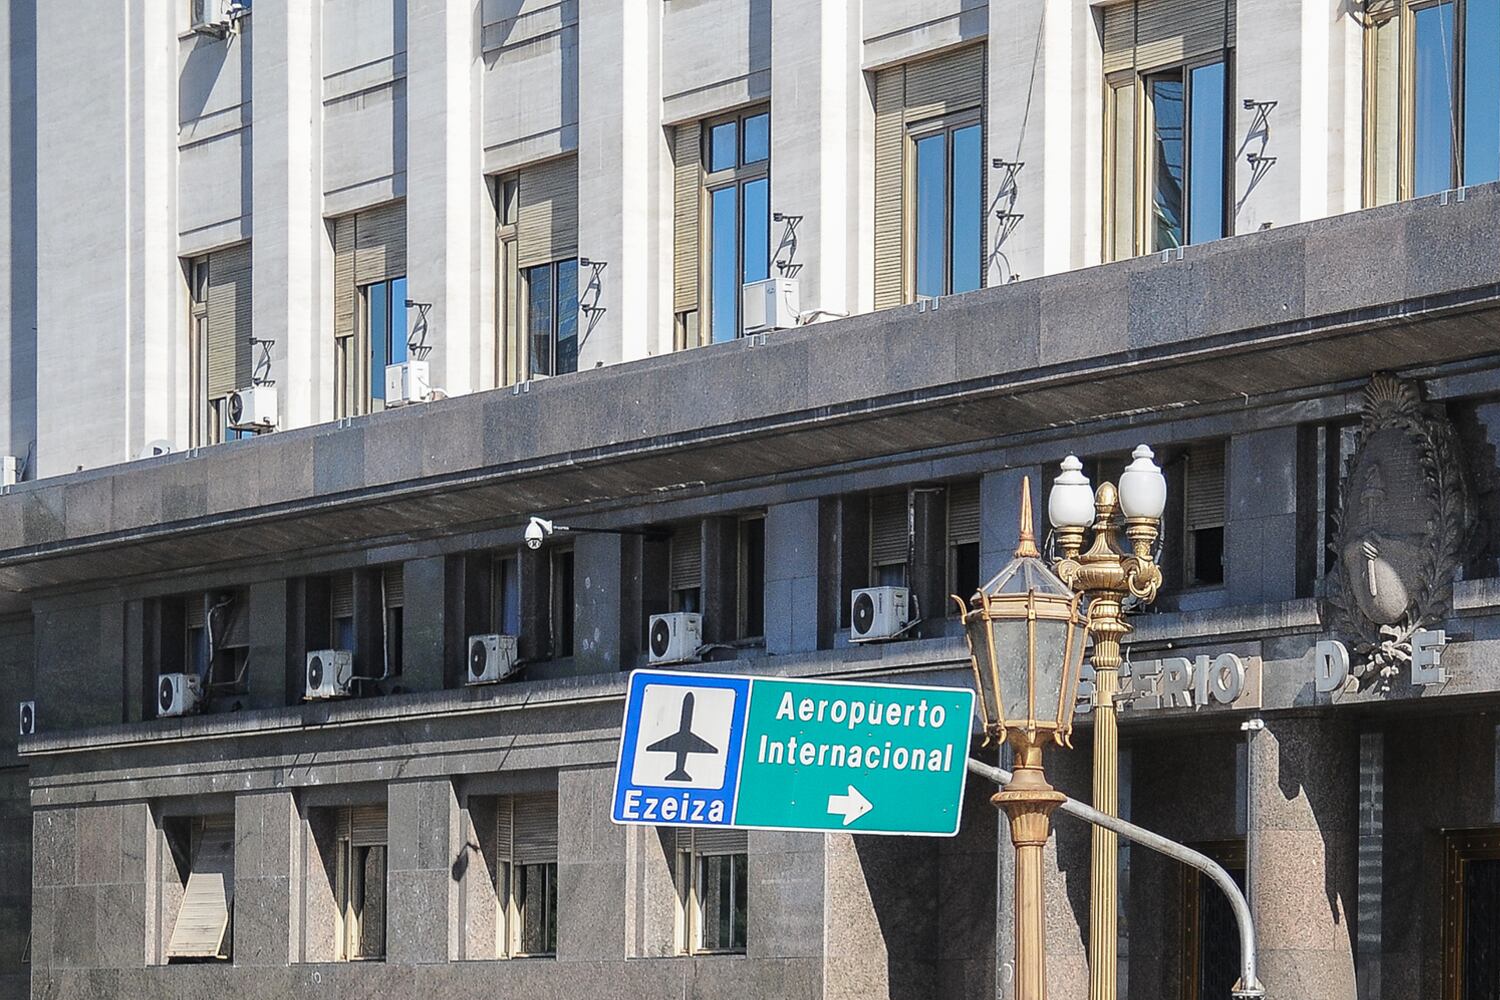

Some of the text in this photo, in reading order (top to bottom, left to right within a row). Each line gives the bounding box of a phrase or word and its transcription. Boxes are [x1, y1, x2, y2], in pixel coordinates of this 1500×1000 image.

[775, 690, 946, 729] Aeropuerto
[757, 734, 953, 772] Internacional
[622, 789, 725, 823] Ezeiza
